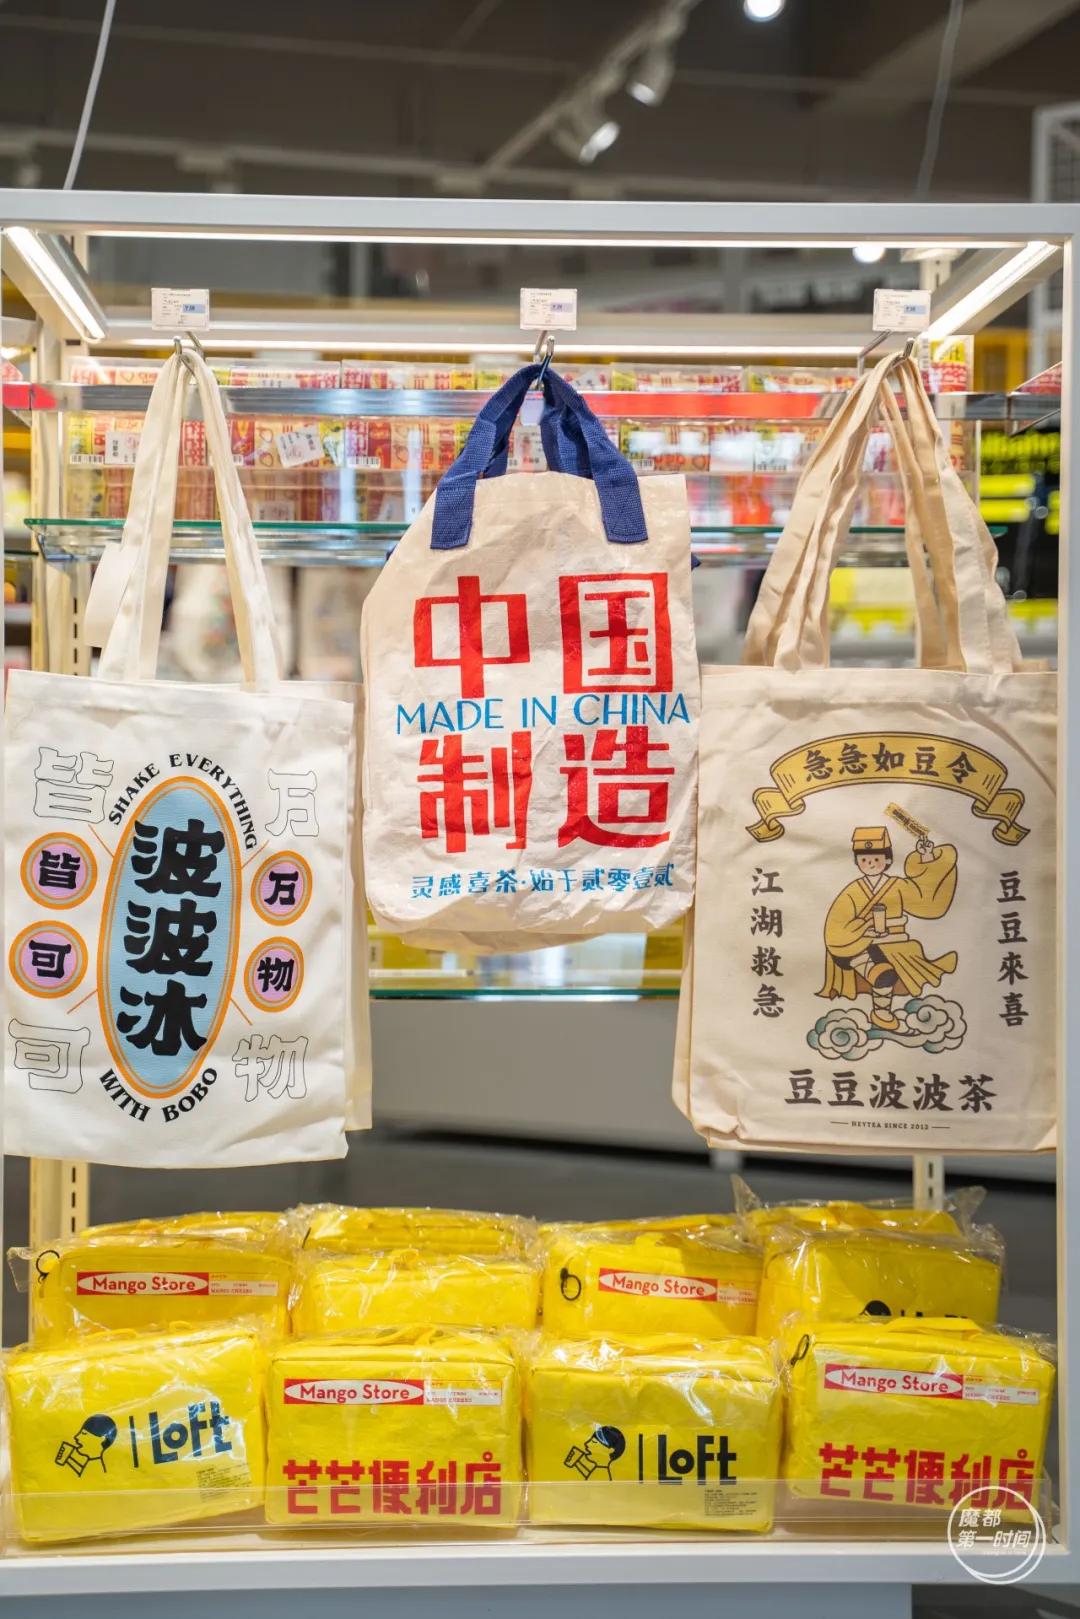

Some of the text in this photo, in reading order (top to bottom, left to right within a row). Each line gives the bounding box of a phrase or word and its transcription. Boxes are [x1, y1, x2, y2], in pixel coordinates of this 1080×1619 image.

[413, 572, 674, 699] 中国
[397, 693, 690, 735] MADE IN CHINA
[33, 747, 115, 825] 皆
[417, 725, 675, 853] 制造
[803, 742, 977, 784] 急急如豆令
[108, 753, 257, 850] SHAKE EVERYTHING
[264, 768, 320, 838] 万
[38, 850, 81, 890] 皆
[263, 870, 299, 906] 万
[28, 939, 72, 979] 可
[116, 818, 226, 1057] 波波冰
[750, 867, 785, 1018] 江湖救急
[996, 870, 1030, 1028] 豆豆來喜
[256, 956, 295, 993] 物
[8, 1018, 91, 1094] 可
[232, 1033, 309, 1102] 物
[99, 1067, 218, 1123] WITH BOBO
[784, 1068, 997, 1114] 豆豆波波茶
[851, 1120, 882, 1129] HEYTEA
[884, 1122, 908, 1130] SINCE
[93, 1276, 147, 1296] Mango
[151, 1275, 196, 1292] Store
[612, 1273, 659, 1294] Mango
[663, 1278, 705, 1297] Store
[300, 1384, 357, 1403] Mango
[362, 1382, 410, 1399] Store
[840, 1368, 897, 1394] Mango
[902, 1374, 949, 1393] Store
[283, 1451, 502, 1515] 芒芒便利店
[819, 1442, 1036, 1511] 芒芒便利店
